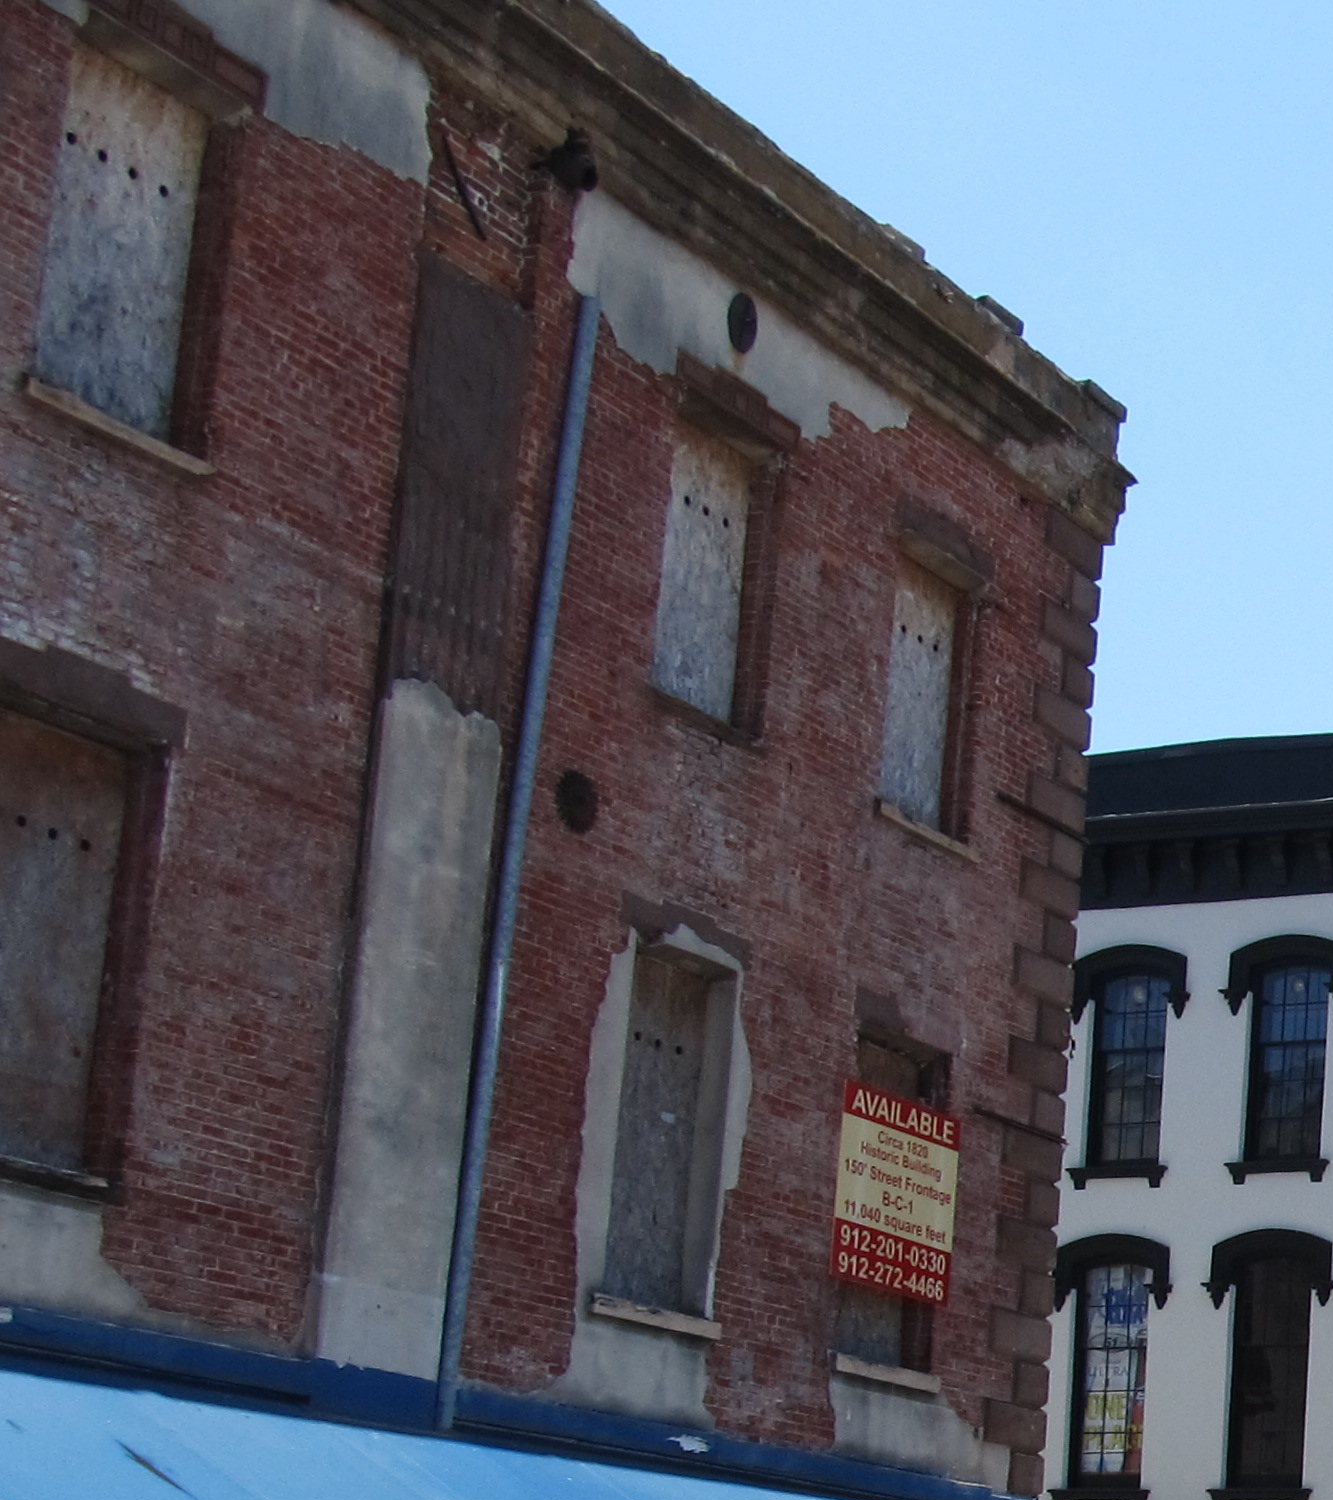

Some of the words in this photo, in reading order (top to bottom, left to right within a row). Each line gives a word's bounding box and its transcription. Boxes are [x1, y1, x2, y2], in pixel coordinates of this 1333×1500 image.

[851, 1088, 955, 1144] AVAILABLE
[878, 1131, 903, 1151] Circa
[861, 1141, 899, 1165] Historic
[901, 1155, 942, 1182] Building
[870, 1166, 902, 1188] Street
[904, 1177, 951, 1206] Frontage
[882, 1191, 914, 1214] B-C-1
[884, 1214, 923, 1236] square
[925, 1225, 947, 1244] feet
[840, 1224, 946, 1275] 912-201-0330
[838, 1251, 945, 1300] 912-272-4466
